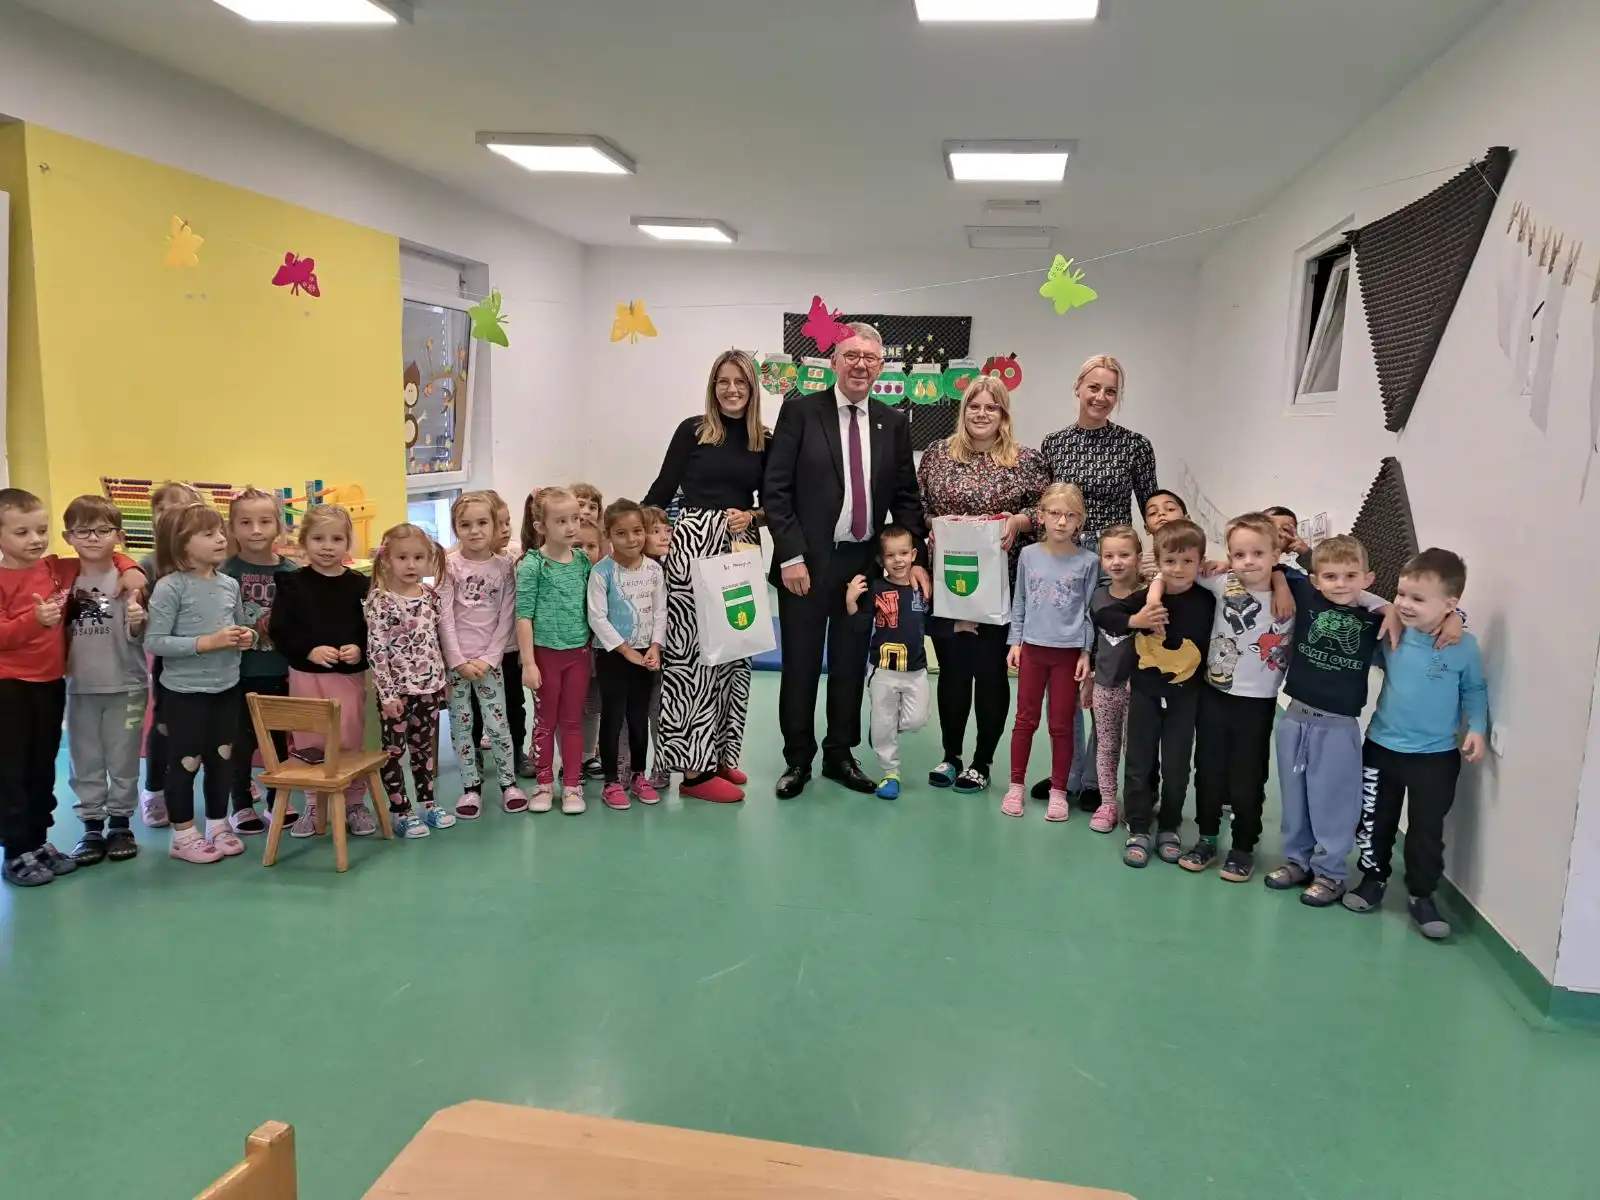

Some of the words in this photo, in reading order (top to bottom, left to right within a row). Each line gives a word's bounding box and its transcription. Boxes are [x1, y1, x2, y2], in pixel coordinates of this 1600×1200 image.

[875, 591, 900, 628] N
[1298, 642, 1329, 662] GAME
[1329, 655, 1363, 670] OVER
